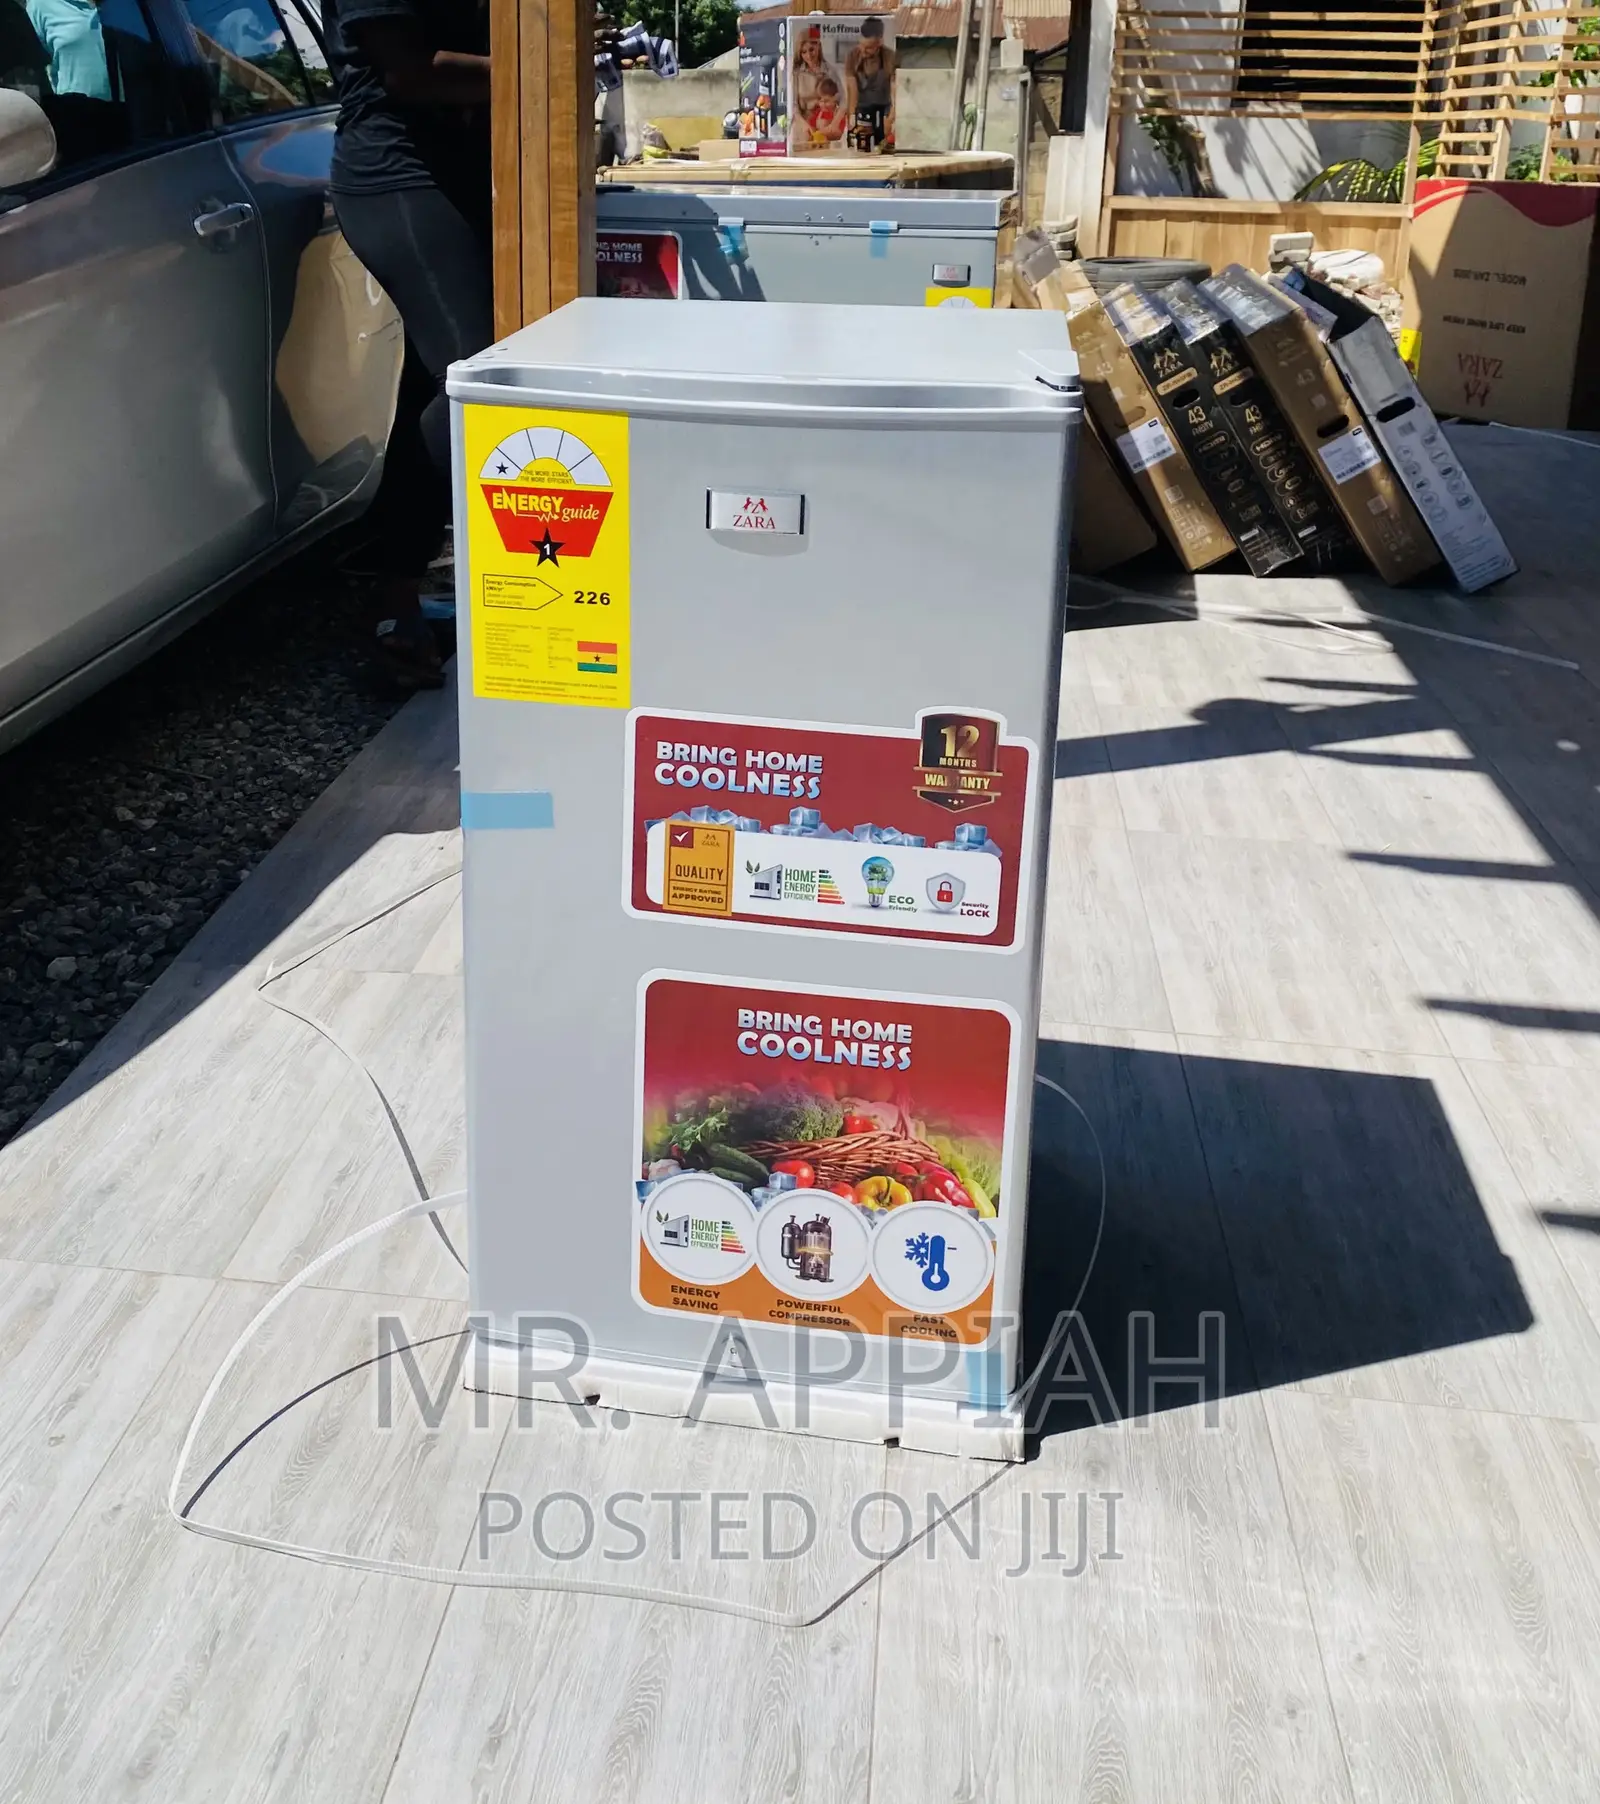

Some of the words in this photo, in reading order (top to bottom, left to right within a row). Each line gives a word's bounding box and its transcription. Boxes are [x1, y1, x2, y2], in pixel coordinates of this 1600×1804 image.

[822, 23, 861, 34] Hoffma
[612, 243, 643, 252] HOME
[596, 251, 643, 263] OLNESS
[1458, 353, 1504, 379] ZARA
[1188, 405, 1206, 426] 43
[1245, 404, 1263, 425] 43
[492, 487, 564, 516] ENERGY
[561, 504, 600, 522] guide
[733, 514, 776, 530] ZARA
[543, 543, 551, 556] 1
[574, 590, 611, 606] 226
[940, 725, 980, 758] 12
[656, 741, 738, 767] BRING
[745, 749, 824, 775] HOME
[939, 757, 977, 768] MONTHS
[654, 762, 821, 800] COOLNESS
[924, 773, 990, 790] WAANTY
[675, 864, 724, 881] QUALITY
[784, 868, 817, 883] HOME
[784, 881, 816, 894] ENERGY
[672, 892, 724, 904] APPROVED
[783, 891, 816, 902] EFFICIENCY
[888, 895, 915, 905] ECO
[888, 904, 918, 913] Friendly
[960, 908, 990, 918] LOCK
[961, 902, 989, 910] Security
[737, 1008, 823, 1035] BRING
[831, 1018, 912, 1044] HOME
[737, 1031, 911, 1071] COOLNESS
[691, 1218, 720, 1233] HOME
[690, 1231, 720, 1243] ENERGY
[690, 1240, 720, 1250] EFFICIENCY
[671, 1285, 721, 1299] ENERGY
[672, 1297, 719, 1311] SAVING
[776, 1299, 844, 1314] POWERFUL
[769, 1309, 851, 1327] COMPRESSOR
[913, 1314, 945, 1325] FAST
[900, 1325, 957, 1338] COOLING
